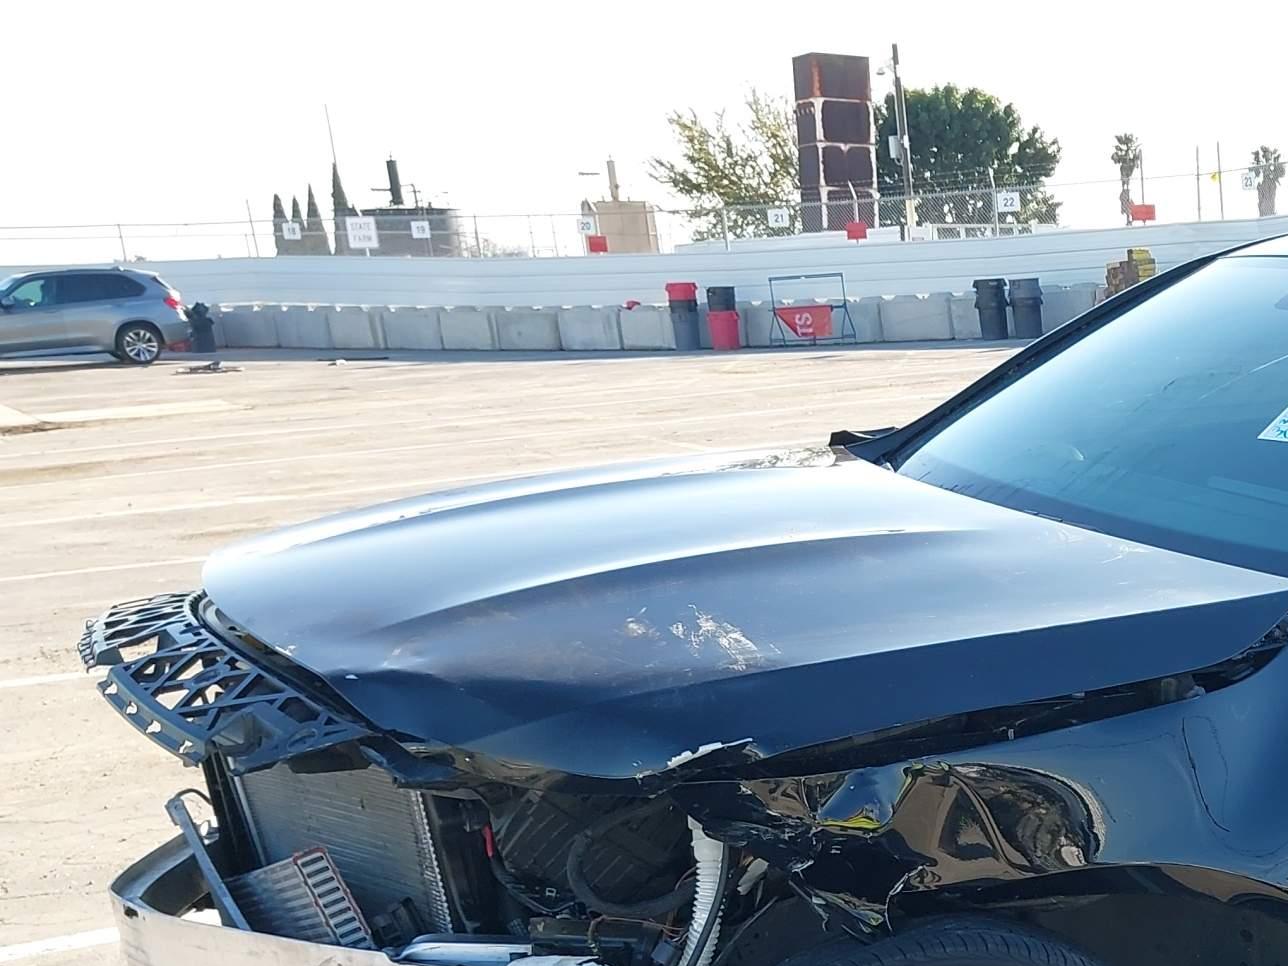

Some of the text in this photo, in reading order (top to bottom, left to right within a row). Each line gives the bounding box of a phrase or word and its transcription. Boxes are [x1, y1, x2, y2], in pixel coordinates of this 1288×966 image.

[1003, 197, 1015, 207] 22
[774, 213, 784, 224] 21
[351, 222, 371, 231] STATE
[580, 221, 591, 231] 20
